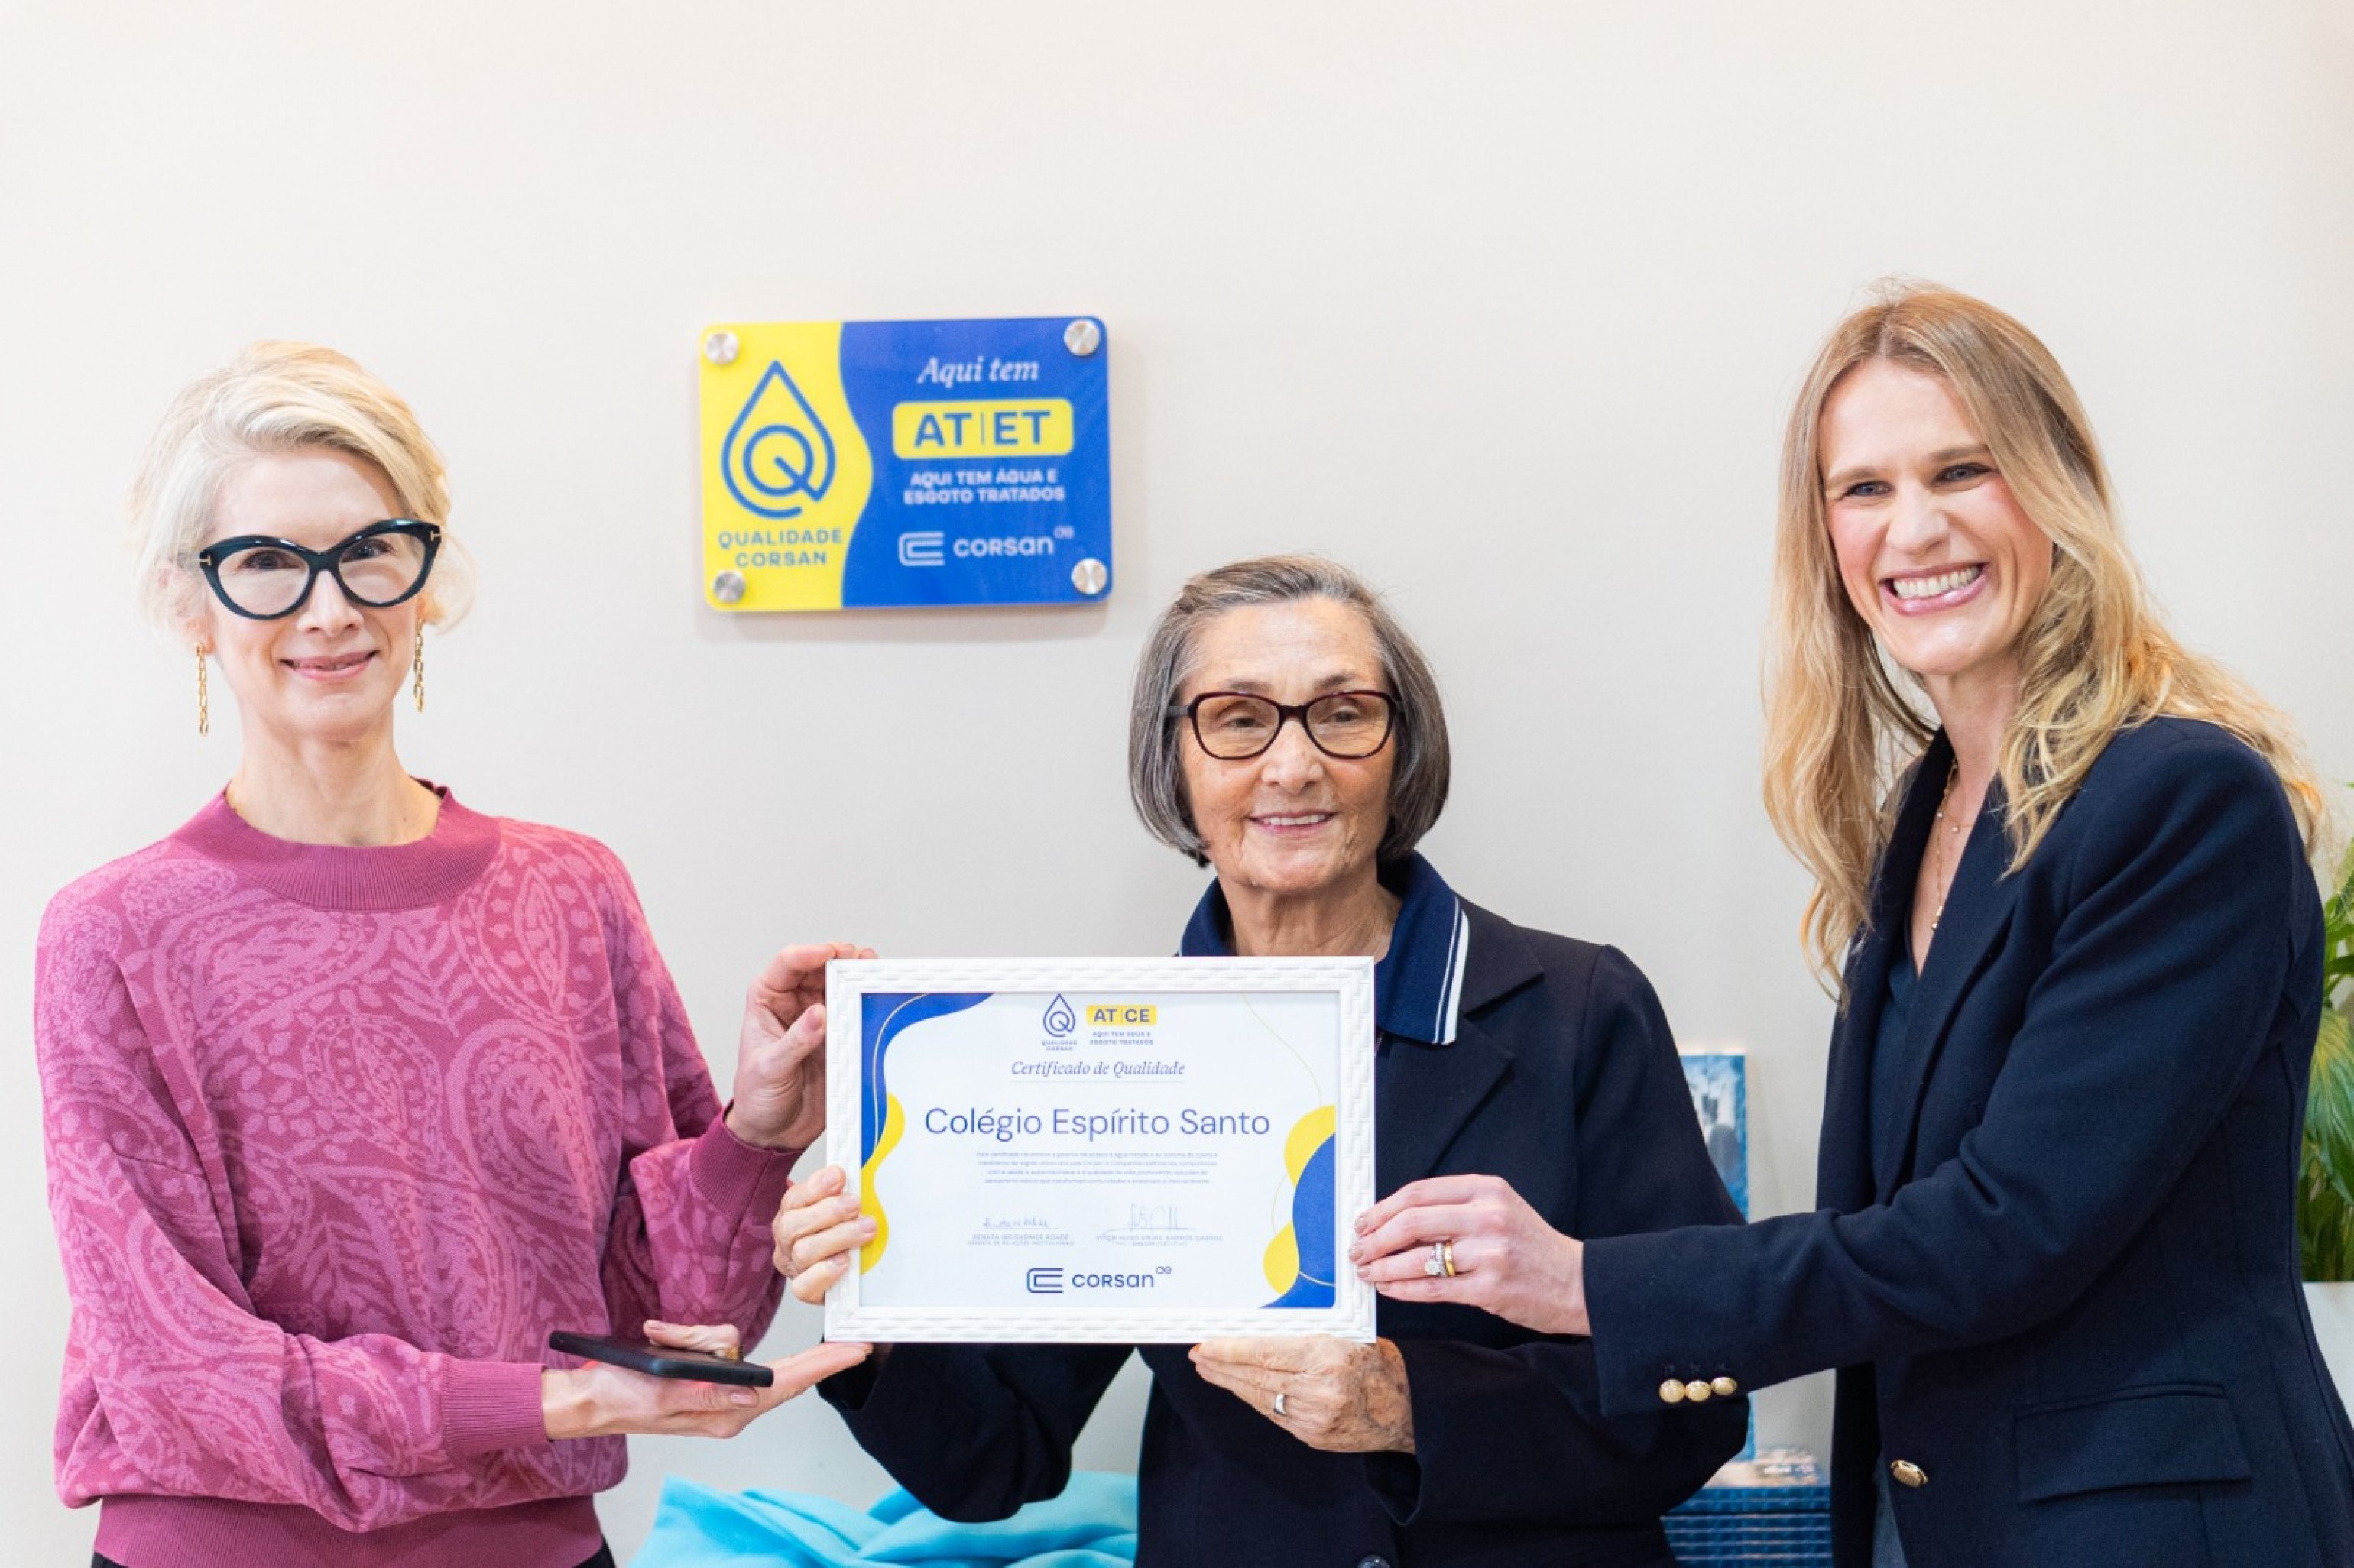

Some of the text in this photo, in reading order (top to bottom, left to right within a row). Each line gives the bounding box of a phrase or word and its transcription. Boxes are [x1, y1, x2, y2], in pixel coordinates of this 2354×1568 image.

[917, 356, 1039, 388] Aqui tem
[909, 467, 1058, 488] AQUI TEM ÁGUA E
[903, 486, 1066, 505] ESGOTO TRATADOS
[718, 528, 842, 549] QUALIDADE
[734, 551, 828, 569] CORSAN
[1011, 1060, 1186, 1078] Certificado de Qualidade
[924, 1106, 1271, 1142] Colégio Espírito Santo
